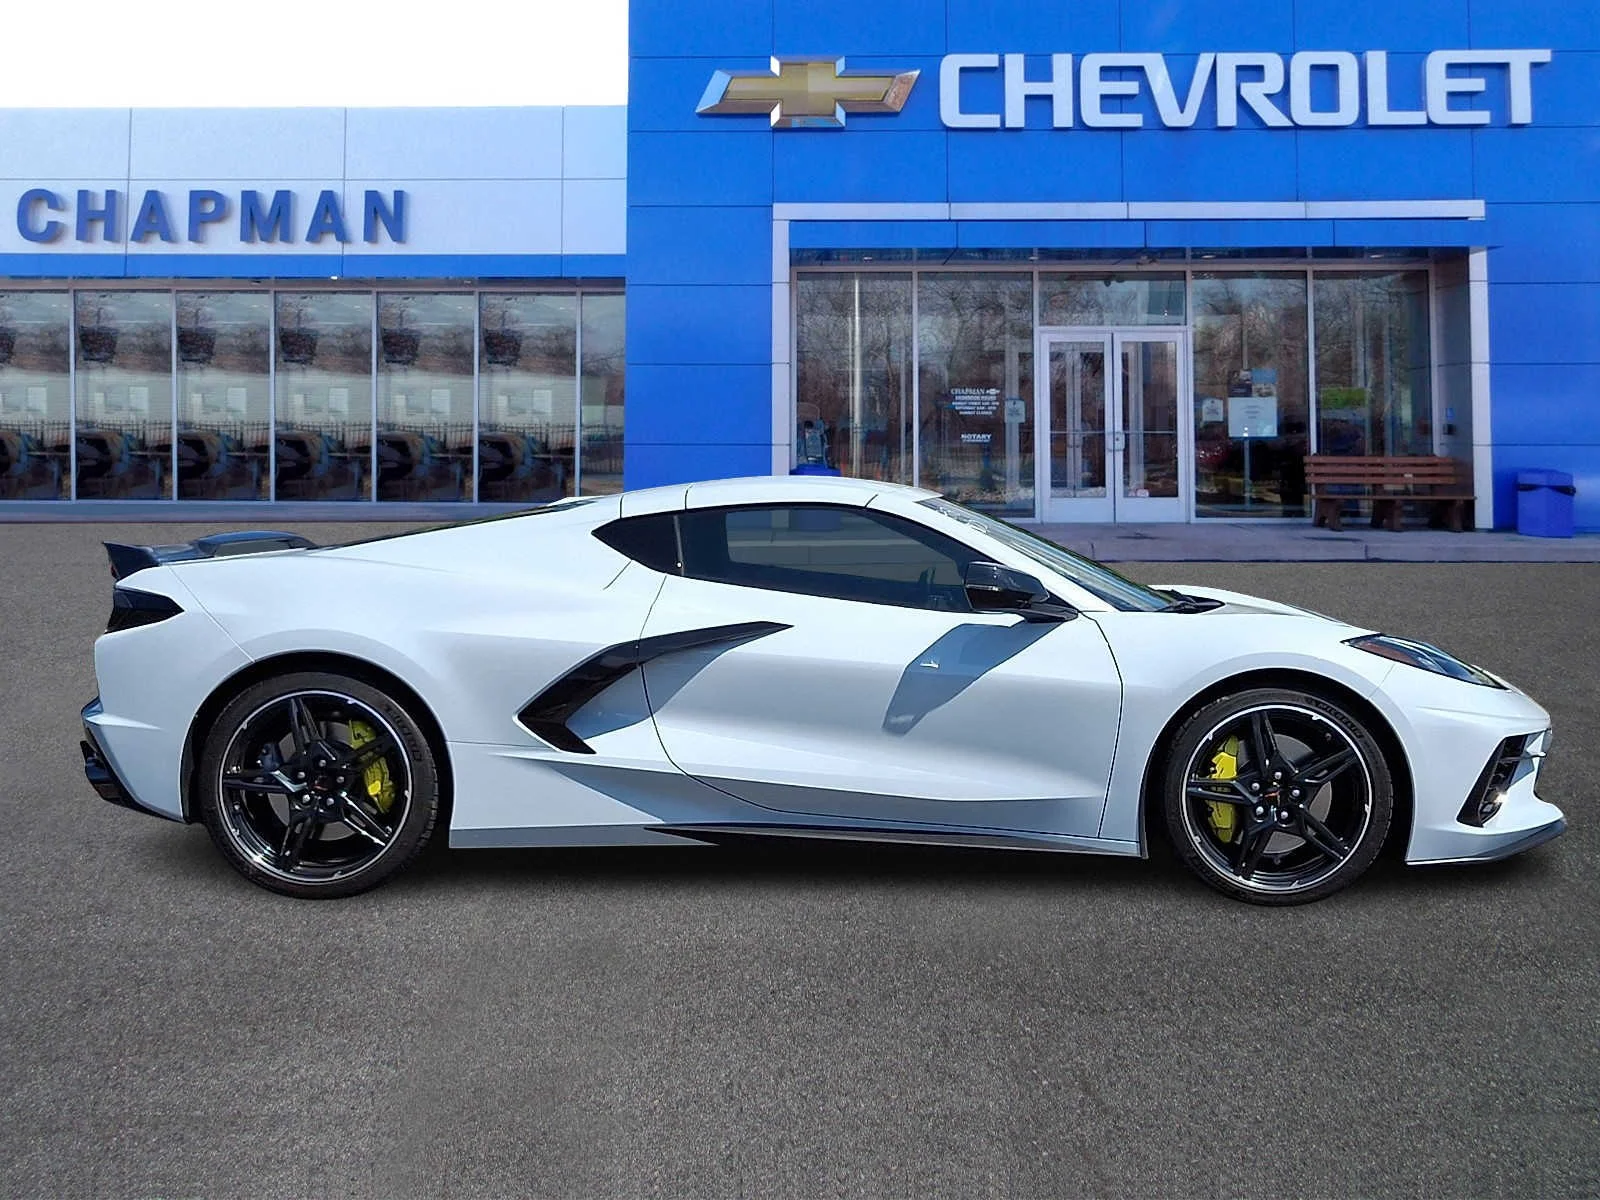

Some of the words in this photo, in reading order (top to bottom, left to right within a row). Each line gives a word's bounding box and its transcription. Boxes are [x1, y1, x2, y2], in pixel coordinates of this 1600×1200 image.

[938, 49, 1552, 129] CHEVROLET
[16, 188, 407, 243] CHAPMAN
[950, 387, 985, 395] CHAPMAN
